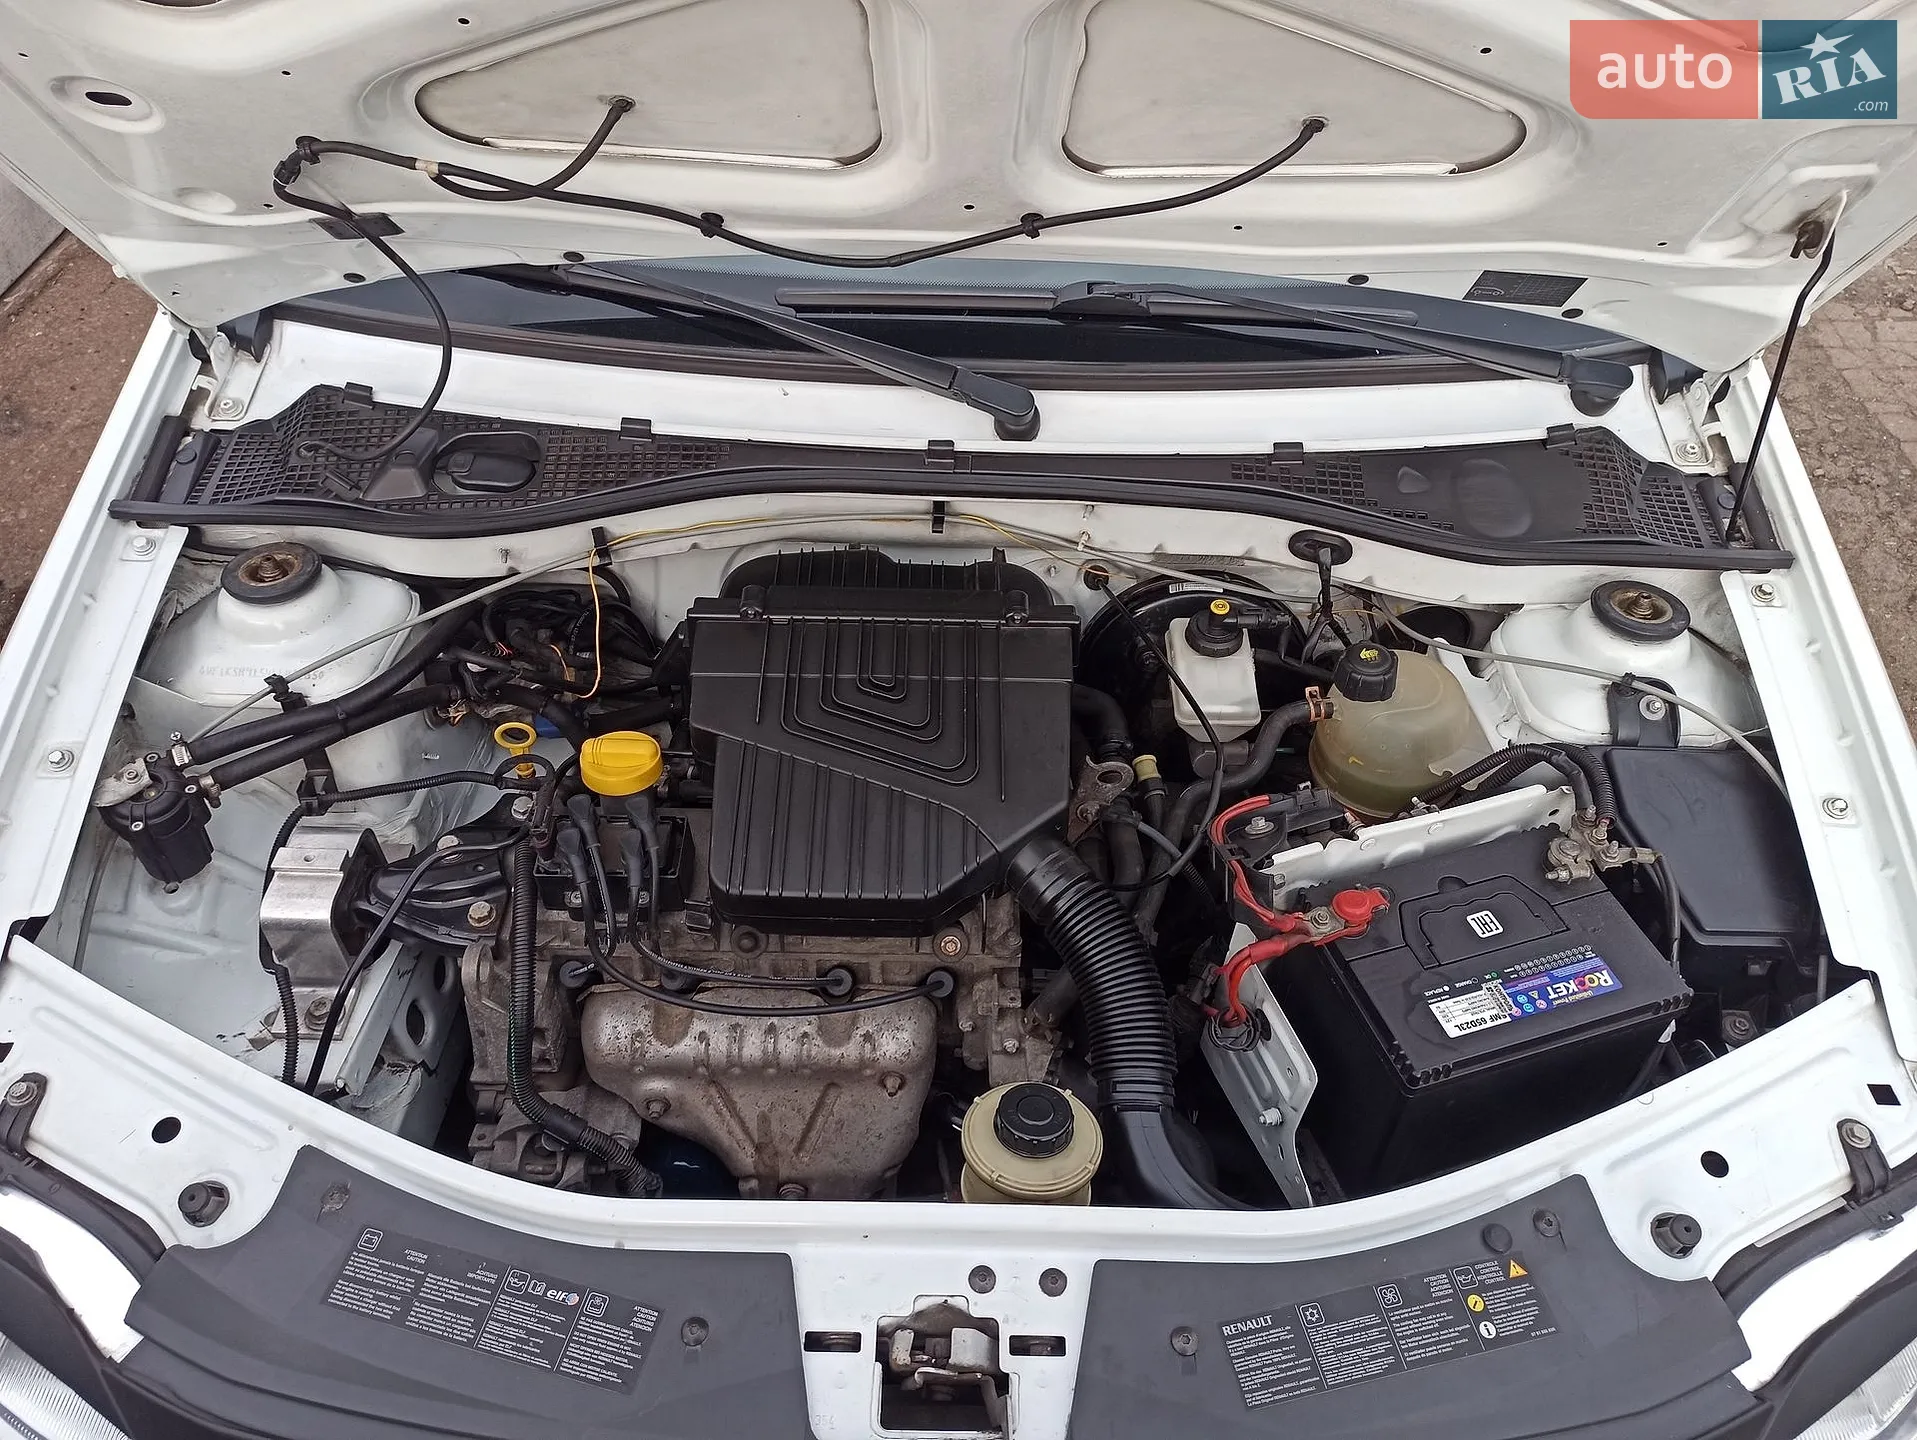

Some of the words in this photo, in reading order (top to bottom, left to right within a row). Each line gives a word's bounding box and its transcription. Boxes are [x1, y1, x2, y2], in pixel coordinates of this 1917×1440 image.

[1547, 969, 1614, 999] ROCKET
[1454, 1017, 1487, 1031] 65D23L
[547, 1289, 568, 1301] elf
[633, 1305, 658, 1316] ATTENTION
[636, 1311, 656, 1321] CAUTION
[1222, 1315, 1272, 1336] RENAULT
